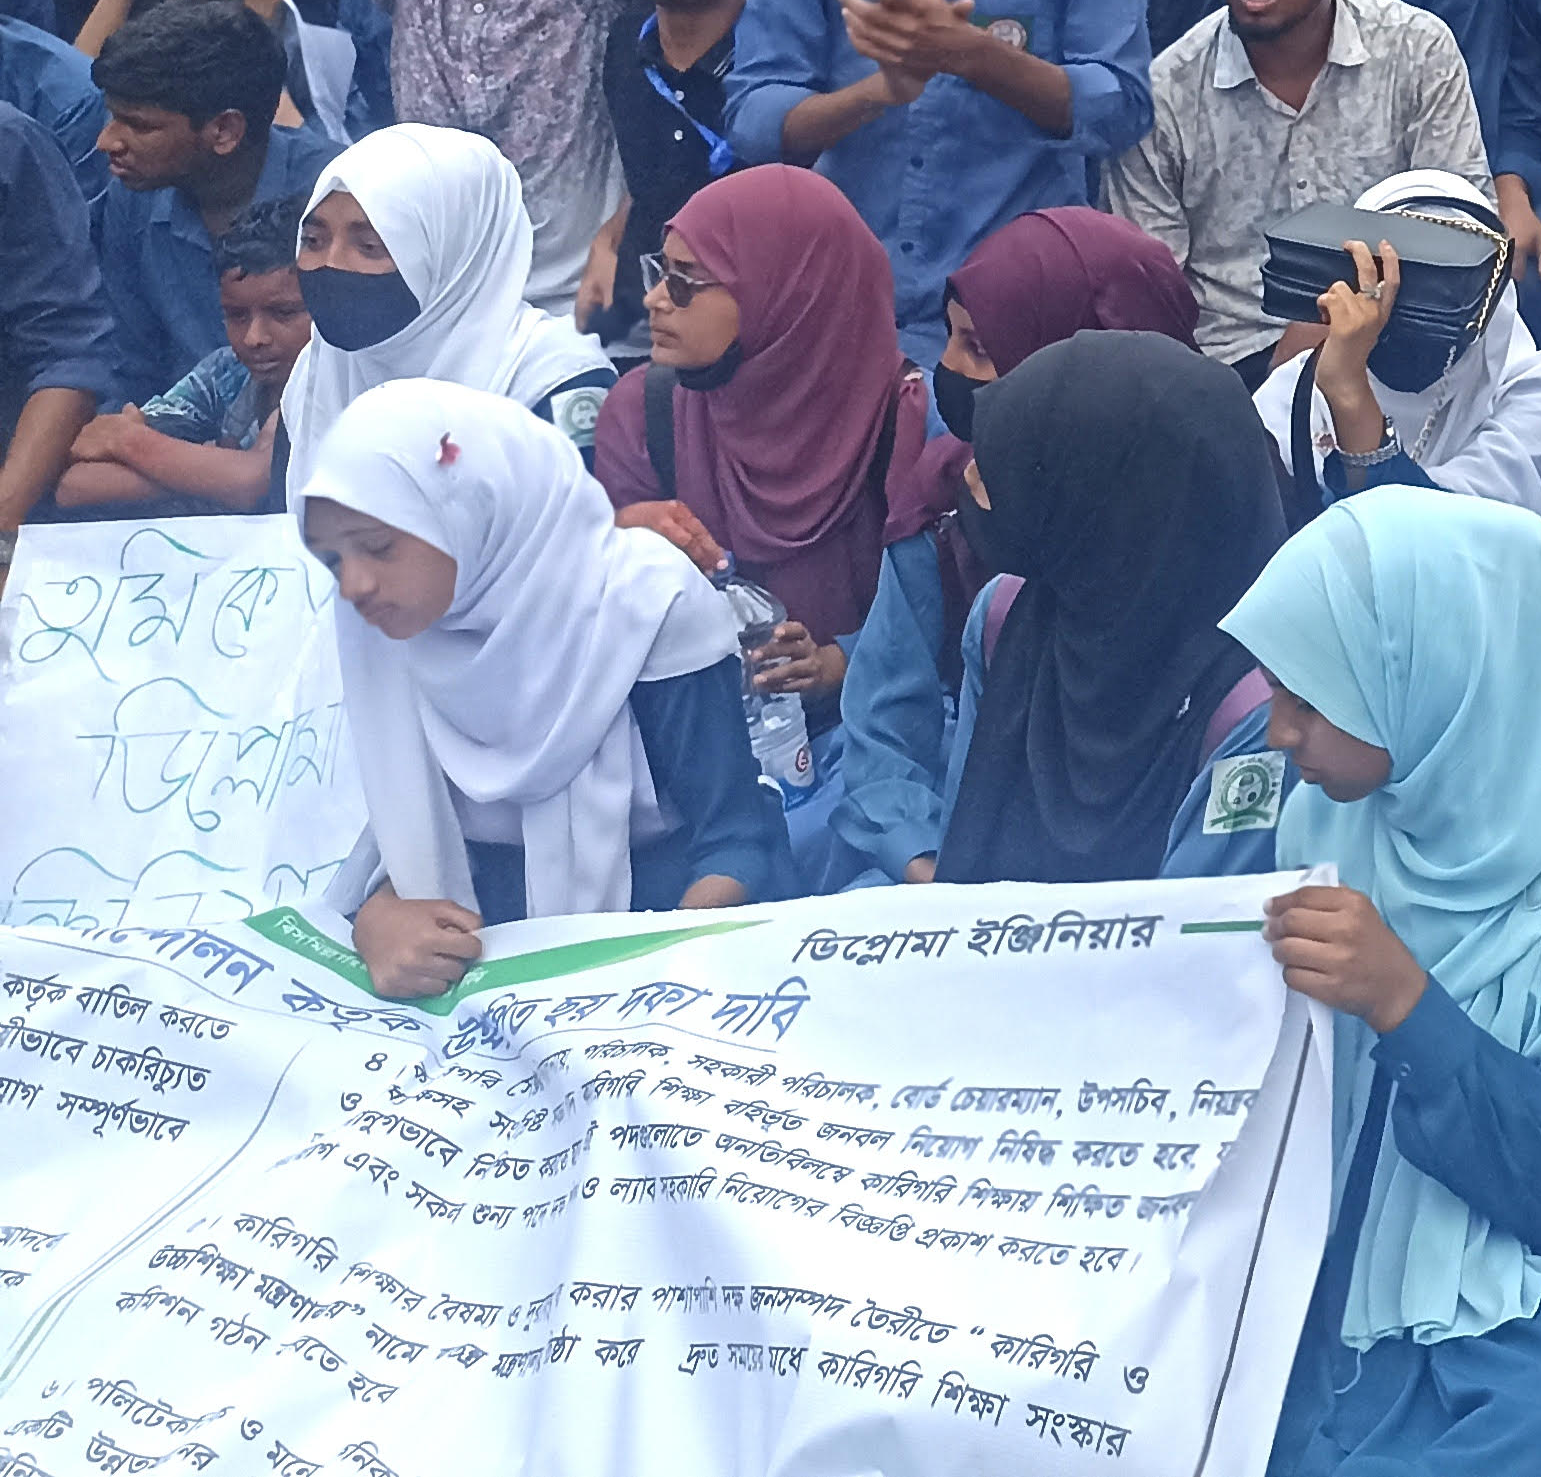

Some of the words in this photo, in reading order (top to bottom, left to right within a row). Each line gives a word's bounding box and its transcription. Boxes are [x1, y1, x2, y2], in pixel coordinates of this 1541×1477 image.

[19, 527, 229, 685] তুমি
[211, 565, 298, 659] কে
[792, 927, 959, 966] ডিপ্লোমা
[967, 909, 1165, 958] ইঞ্জিনিয়ার
[2, 973, 73, 1013] কর্তৃক
[75, 983, 153, 1024] বাতিল
[159, 1004, 238, 1040] করতে
[616, 981, 713, 1022] দফা
[711, 976, 812, 1044] দাবি
[91, 1044, 212, 1093] চাকরিচ্যুত
[688, 1054, 778, 1087] সহকারী
[57, 1091, 191, 1142] সম্পূর্ণভাবে
[648, 1076, 717, 1107] শিক্ষা
[815, 1121, 897, 1152] জনবল
[899, 1124, 984, 1160] নিয়োগ
[1071, 1140, 1146, 1169] করতে
[343, 1152, 400, 1195] এবং
[714, 1132, 855, 1183] অনতিবিলম্বে
[860, 1169, 957, 1205] কারিগরি
[233, 1212, 339, 1274] কারিগরি
[715, 1171, 830, 1218] নিয়োগের
[915, 1227, 995, 1256] প্রকাশ
[998, 1236, 1077, 1266] করতে
[209, 1312, 272, 1354] গঠন
[347, 1370, 399, 1404] হবে
[365, 1322, 430, 1363] নামে
[569, 1281, 643, 1312] করার
[750, 1285, 852, 1320] জনসম্পদ
[850, 1298, 958, 1344] তৈরীতে
[991, 1333, 1101, 1382] কারিগরি
[1124, 1366, 1150, 1395] ও
[240, 1416, 264, 1441] ও
[594, 1337, 646, 1368] করে
[817, 1349, 925, 1400] কারিগরি
[931, 1370, 1010, 1426] শিক্ষা
[1025, 1402, 1132, 1458] সংস্কার
